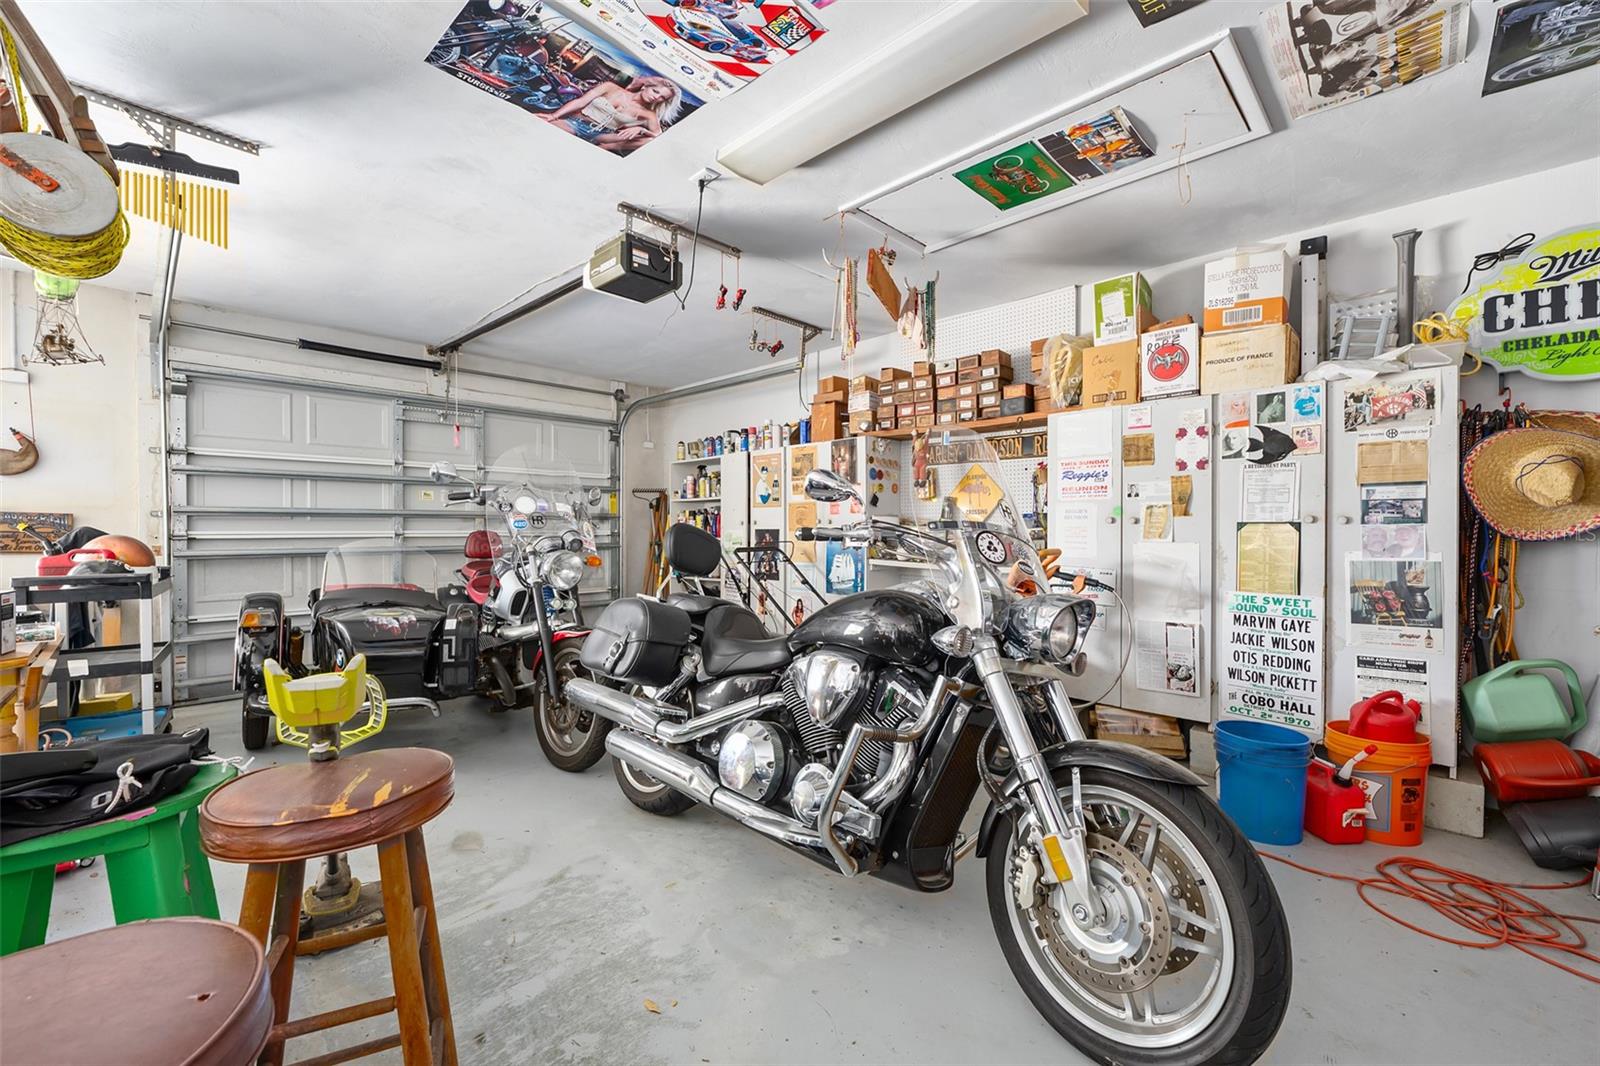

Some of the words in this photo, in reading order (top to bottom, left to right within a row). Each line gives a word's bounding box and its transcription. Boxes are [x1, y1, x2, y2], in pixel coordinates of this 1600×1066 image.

[456, 71, 495, 94] STURGIS
[1146, 339, 1181, 356] ROPE
[1540, 342, 1591, 368] Light
[1205, 356, 1235, 366] PRODUCE
[1246, 352, 1274, 361] FRANCE
[928, 444, 960, 462] ARLEY
[1061, 469, 1109, 482] Reggie's
[1233, 594, 1257, 604] THE
[1263, 596, 1311, 608] SWEET
[1233, 613, 1276, 630] MARVIN
[1281, 618, 1312, 634] GAYE
[1282, 608, 1316, 619] SOUL
[1230, 631, 1265, 647] JACKIE
[1271, 636, 1315, 654] WILSON
[1233, 650, 1257, 665] OTIS
[1262, 654, 1311, 673] REDDING
[1227, 667, 1265, 684] WILSON
[1270, 674, 1317, 692] PICKETT
[1228, 691, 1237, 700] THE
[1241, 693, 1275, 708] COBO
[1280, 700, 1315, 716] HALL
[1229, 705, 1255, 717] OCT.
[1283, 716, 1311, 727] 1970
